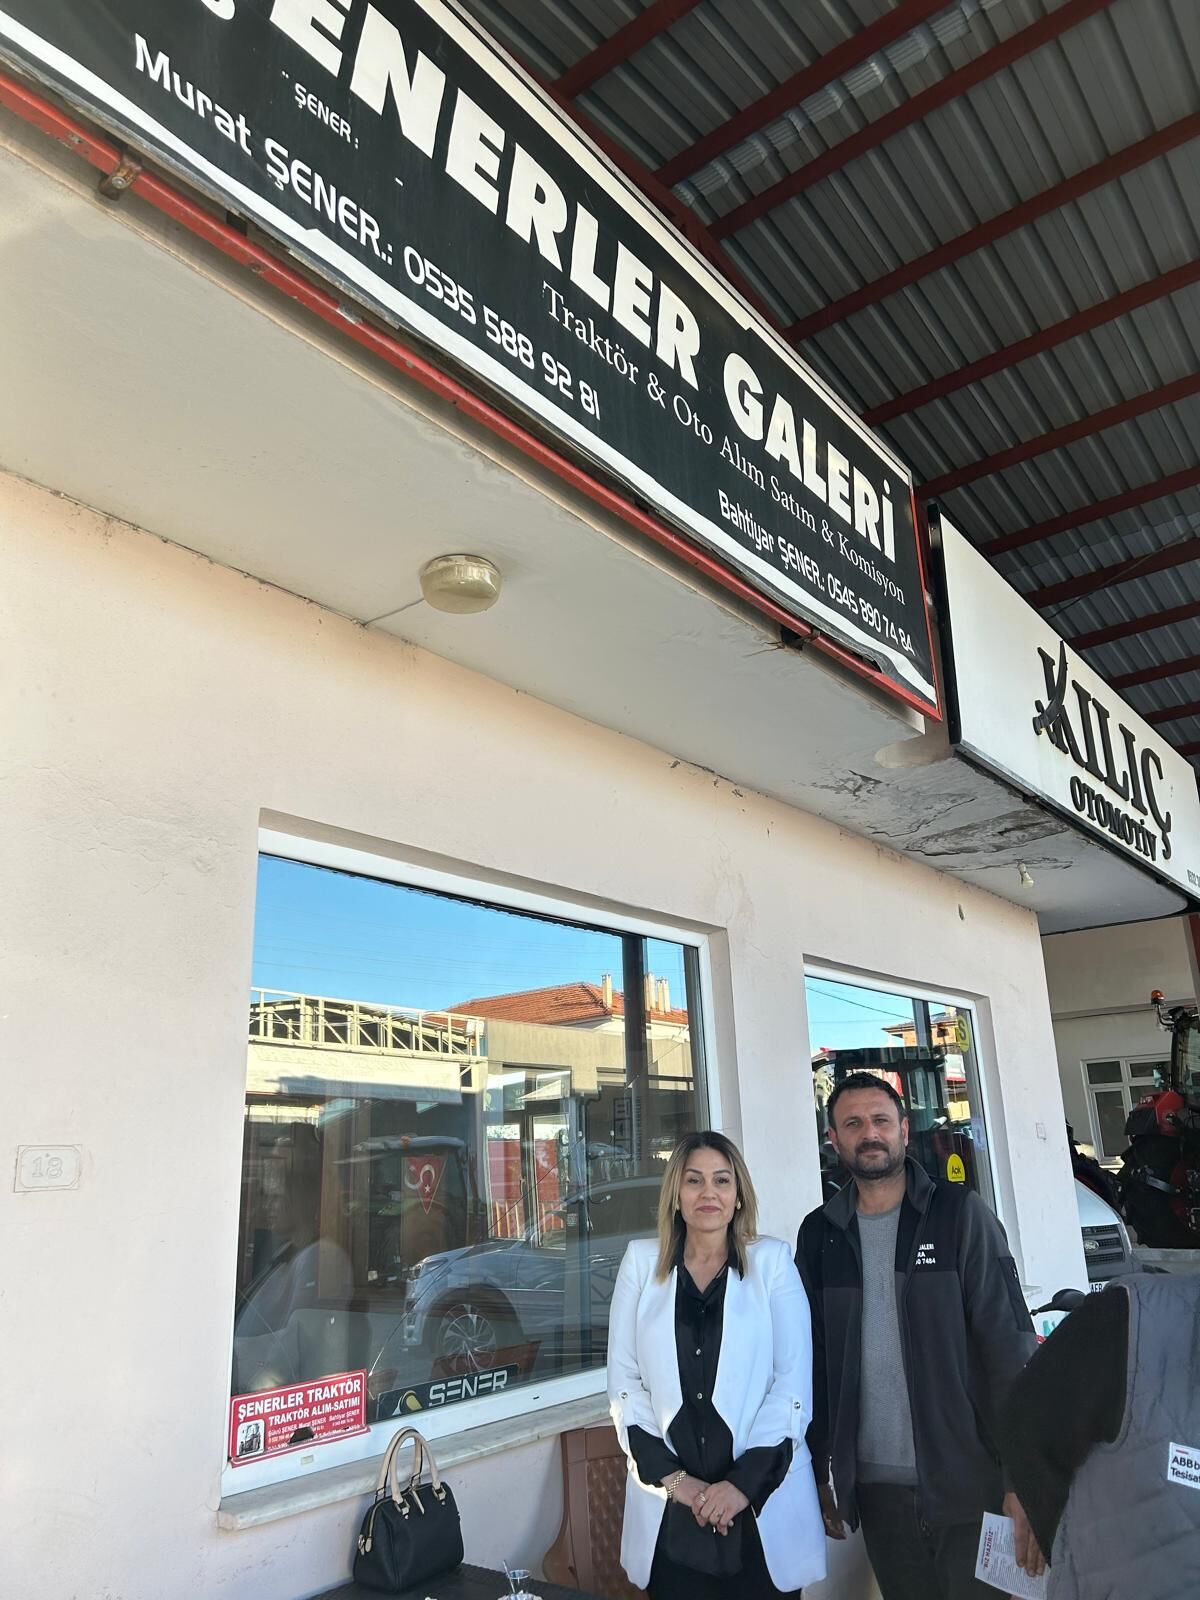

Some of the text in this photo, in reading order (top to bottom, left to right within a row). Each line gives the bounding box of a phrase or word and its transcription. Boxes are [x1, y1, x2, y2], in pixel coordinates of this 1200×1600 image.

[135, 33, 252, 156] Murat
[404, 246, 477, 325] 0535
[483, 305, 535, 370] 588
[541, 352, 574, 400] 92
[579, 380, 600, 420] 81
[542, 280, 906, 605] Traktör & Oto Alım Satım & Komisyon
[723, 352, 896, 564] GALERİ
[718, 489, 774, 552] Bahtiyar
[827, 573, 859, 615] 0545
[859, 598, 882, 633] 890
[883, 616, 899, 644] 74
[898, 628, 916, 656] 84
[1033, 640, 1171, 860] KILIÇ
[1070, 775, 1158, 862] OTOMOTİV
[32, 1156, 63, 1178] 18
[238, 1378, 360, 1422] ŞENERLER TRAKTÖR
[268, 1408, 309, 1426] TRAKTÖR
[311, 1396, 360, 1416] ALIM-SATIMI
